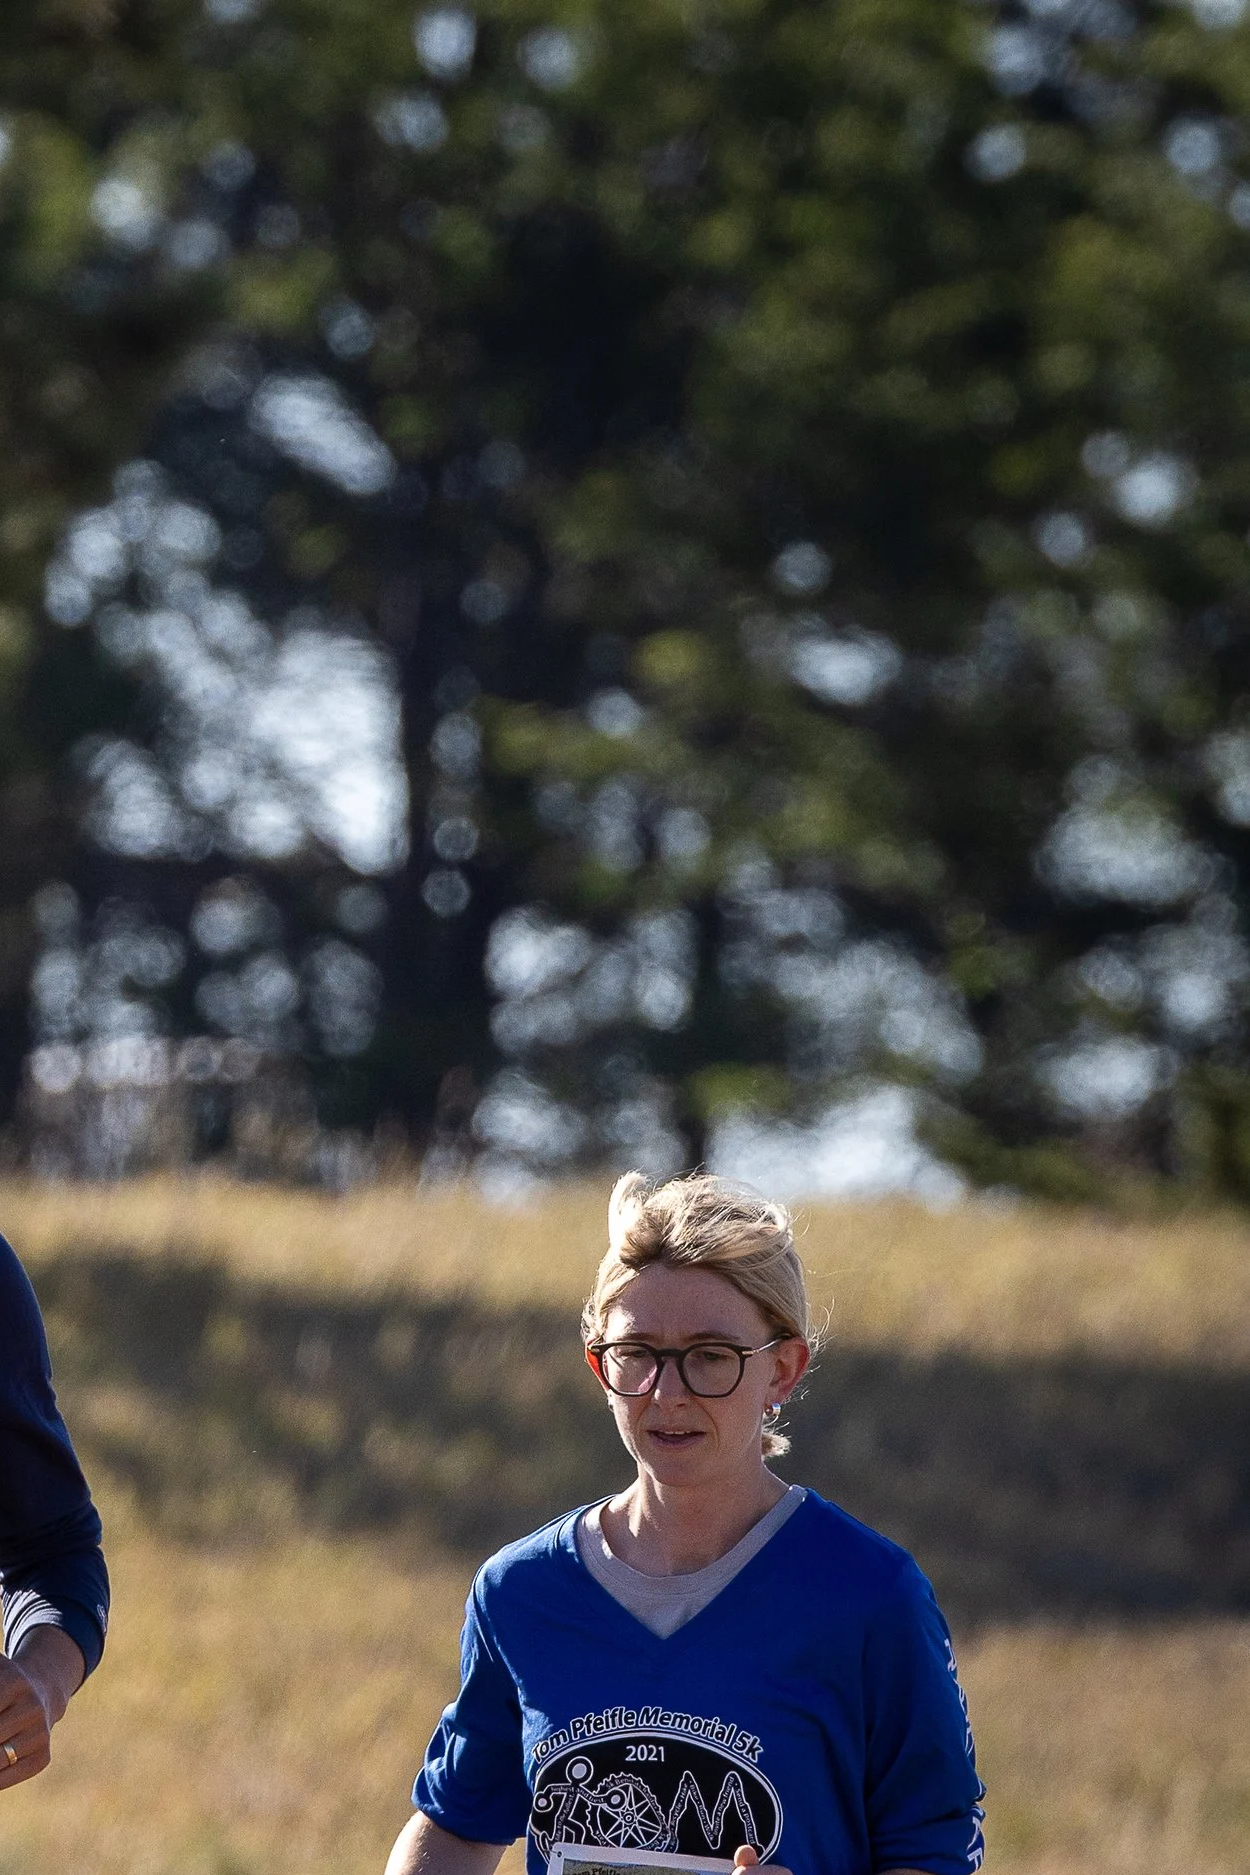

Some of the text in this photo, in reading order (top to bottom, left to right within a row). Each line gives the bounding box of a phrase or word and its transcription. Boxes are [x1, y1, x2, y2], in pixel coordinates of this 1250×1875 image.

[532, 1705, 764, 1764] Tom Pfeifle Memorial 5k
[625, 1744, 665, 1762] 2021
